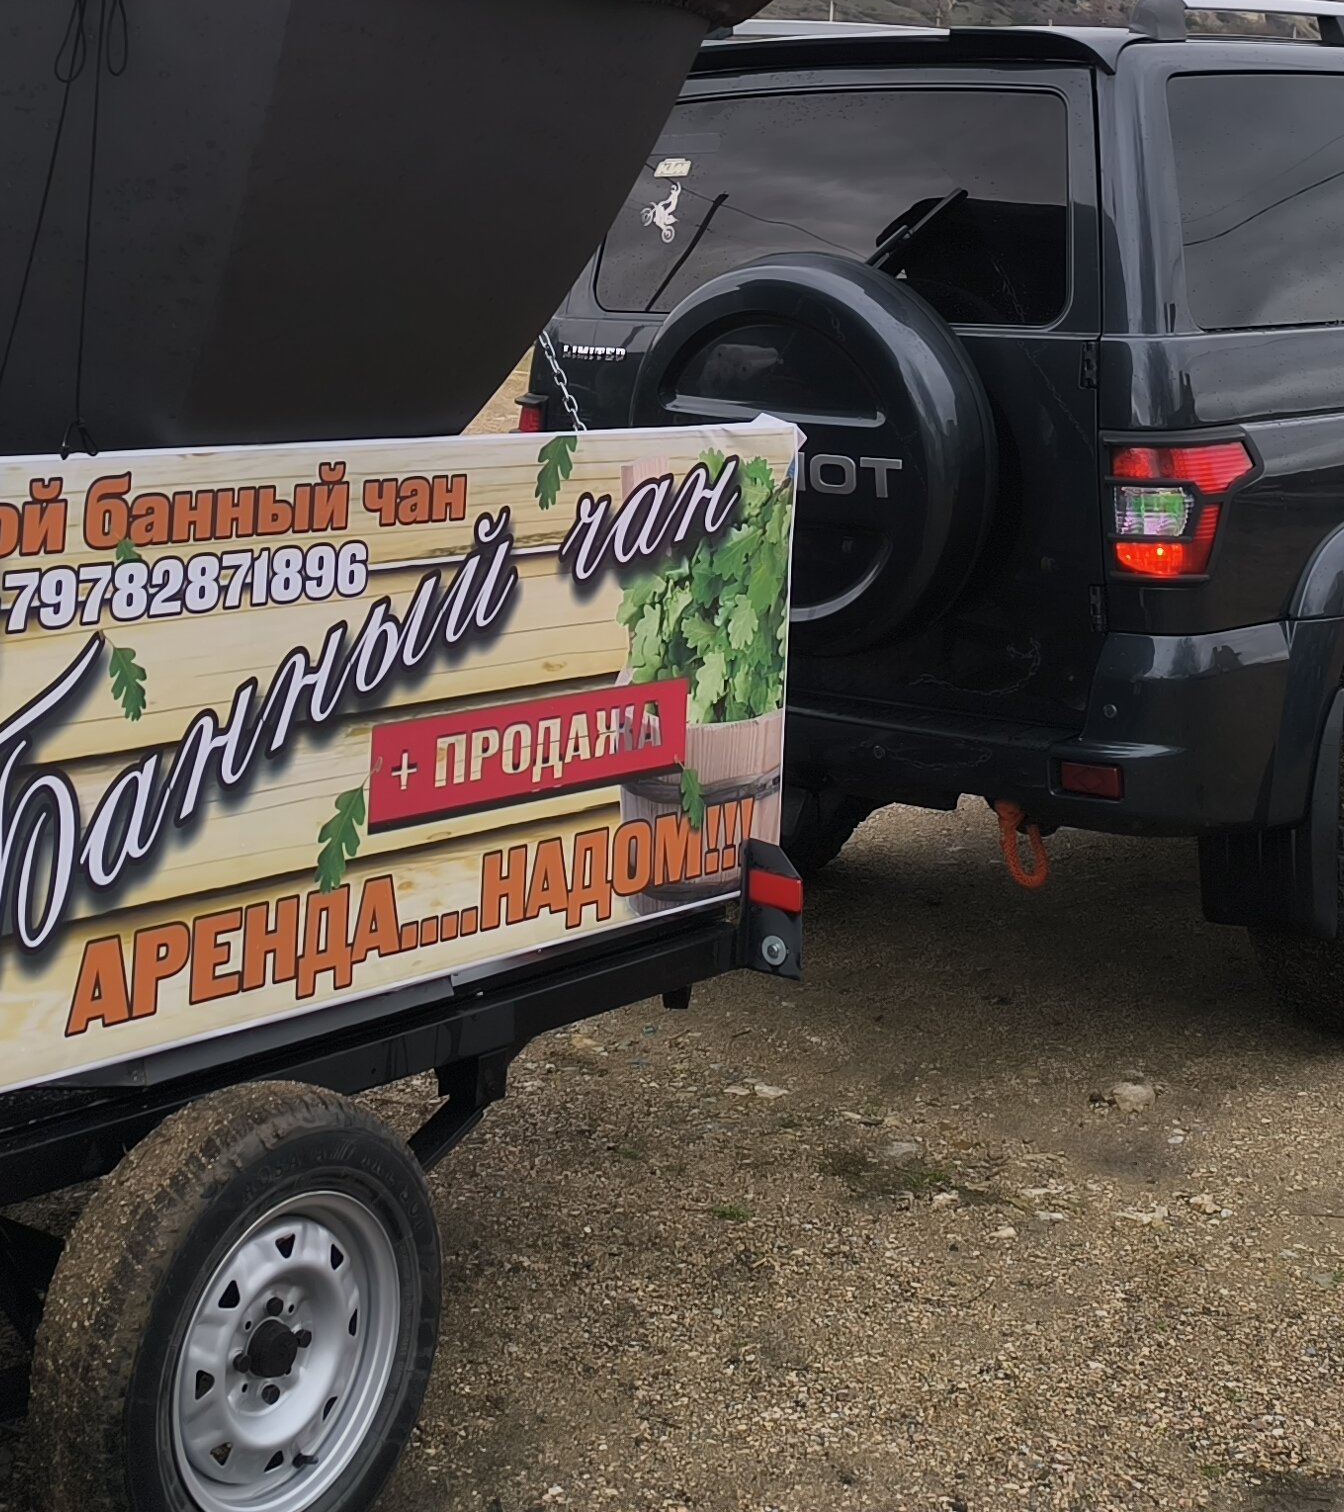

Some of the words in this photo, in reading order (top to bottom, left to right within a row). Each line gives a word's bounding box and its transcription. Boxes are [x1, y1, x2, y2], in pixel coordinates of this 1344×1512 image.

[562, 343, 627, 362] LIMITED
[83, 461, 350, 550] банный
[362, 473, 468, 527] чан
[558, 454, 742, 582] чан
[431, 701, 662, 789] ПРОДАЖА
